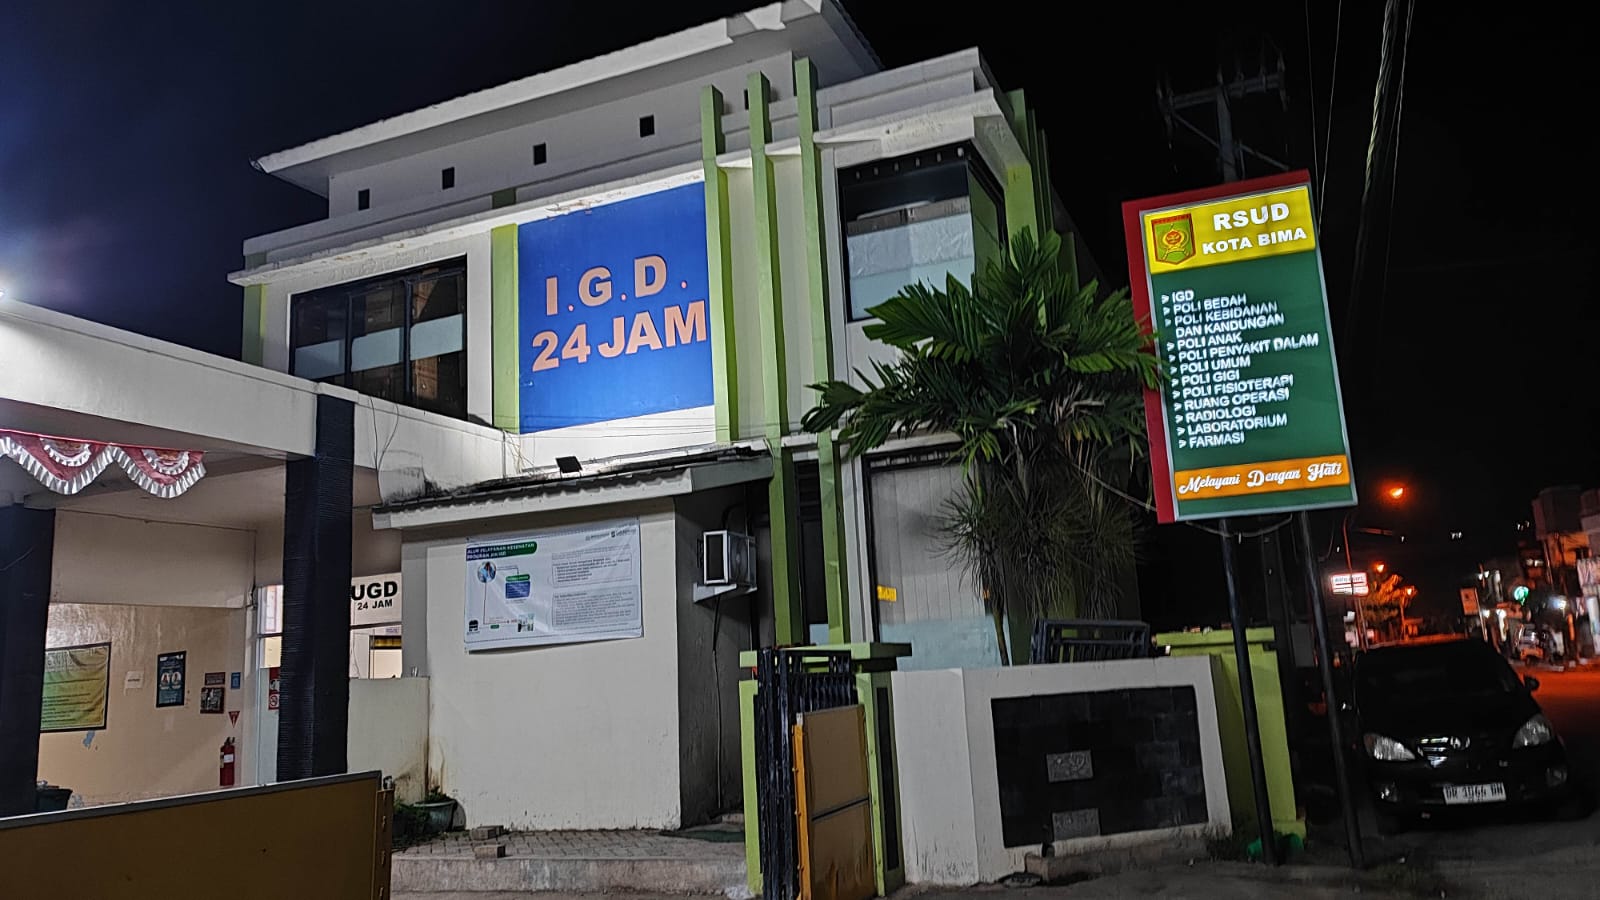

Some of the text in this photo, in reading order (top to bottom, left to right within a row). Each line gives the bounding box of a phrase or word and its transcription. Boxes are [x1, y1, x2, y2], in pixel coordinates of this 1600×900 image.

[1213, 203, 1289, 231] RSUD
[1202, 228, 1307, 254] KOTA BIMA
[1172, 290, 1194, 301] IGD
[1174, 294, 1246, 315] POLI BEDAH
[1175, 302, 1277, 326] POLI KEBIDANAN
[1175, 313, 1284, 338] DAN KANDUNGAN
[532, 300, 707, 372] 24 JAM
[1177, 332, 1242, 350] POLI ANAK
[1179, 333, 1319, 362] POLI PENYAKIT DALAM
[1180, 356, 1250, 374] POLI UMUM
[1181, 369, 1240, 387] POLI GIGI
[1183, 374, 1294, 399] POLI FISIOTERAPI
[1184, 387, 1289, 412] RUANG OPERASI
[1185, 405, 1256, 423] RADIOLOGI
[1187, 413, 1287, 436] LABORATORIUM
[1189, 431, 1244, 449] FARMASI
[1178, 462, 1342, 494] Melayani Dengan Hati
[351, 581, 398, 600] UGD
[357, 599, 393, 610] 24 JAM
